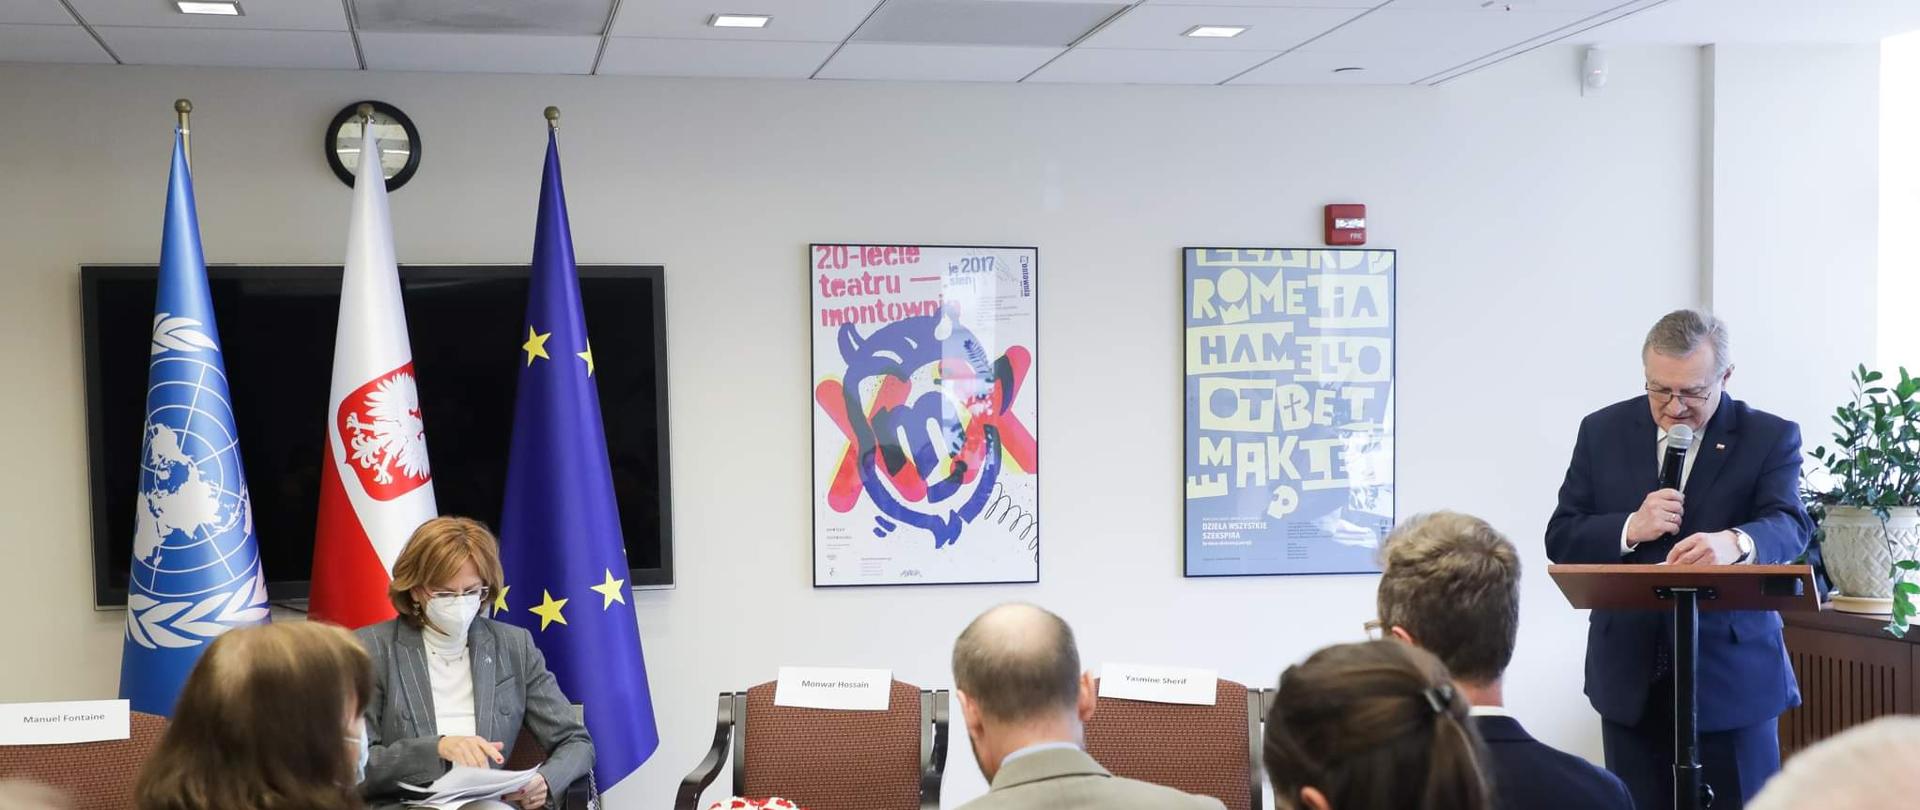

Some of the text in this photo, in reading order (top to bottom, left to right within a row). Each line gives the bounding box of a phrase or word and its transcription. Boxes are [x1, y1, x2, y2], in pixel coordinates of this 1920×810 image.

[961, 256, 995, 273] 2017
[819, 271, 901, 298] teatru
[801, 680, 869, 689] Monwar Hossain
[23, 713, 105, 723] Manuel Fontaine
